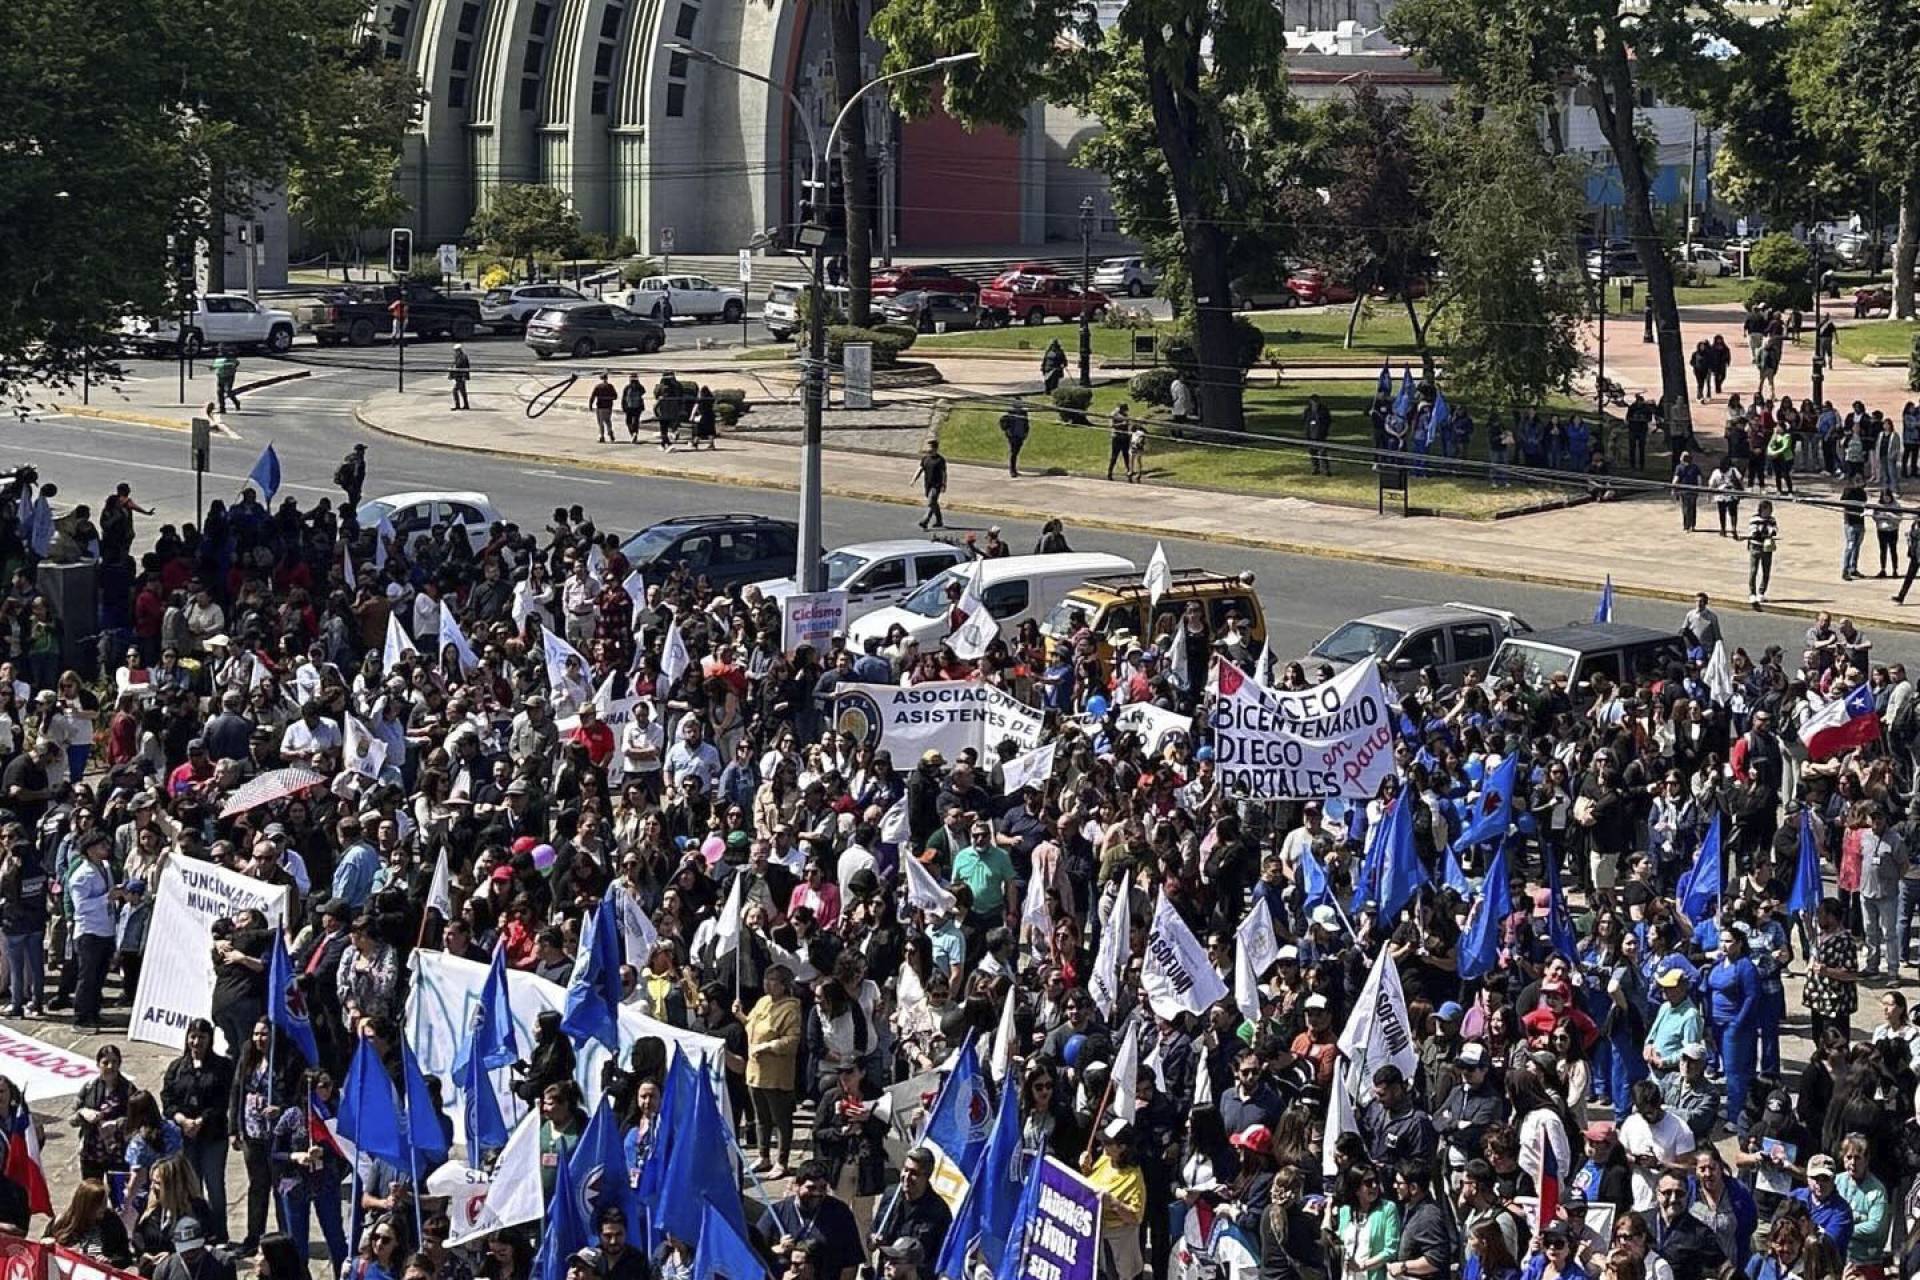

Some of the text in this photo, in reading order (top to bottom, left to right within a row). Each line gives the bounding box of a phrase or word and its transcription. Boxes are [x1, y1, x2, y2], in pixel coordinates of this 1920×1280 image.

[792, 606, 842, 621] Ciclismo
[1259, 686, 1341, 719] LICEO
[894, 708, 1037, 736] ASISTENTES DE
[1216, 733, 1302, 767] DIEGO
[1322, 727, 1391, 795] en paro
[1377, 984, 1409, 1056] SOFUMI
